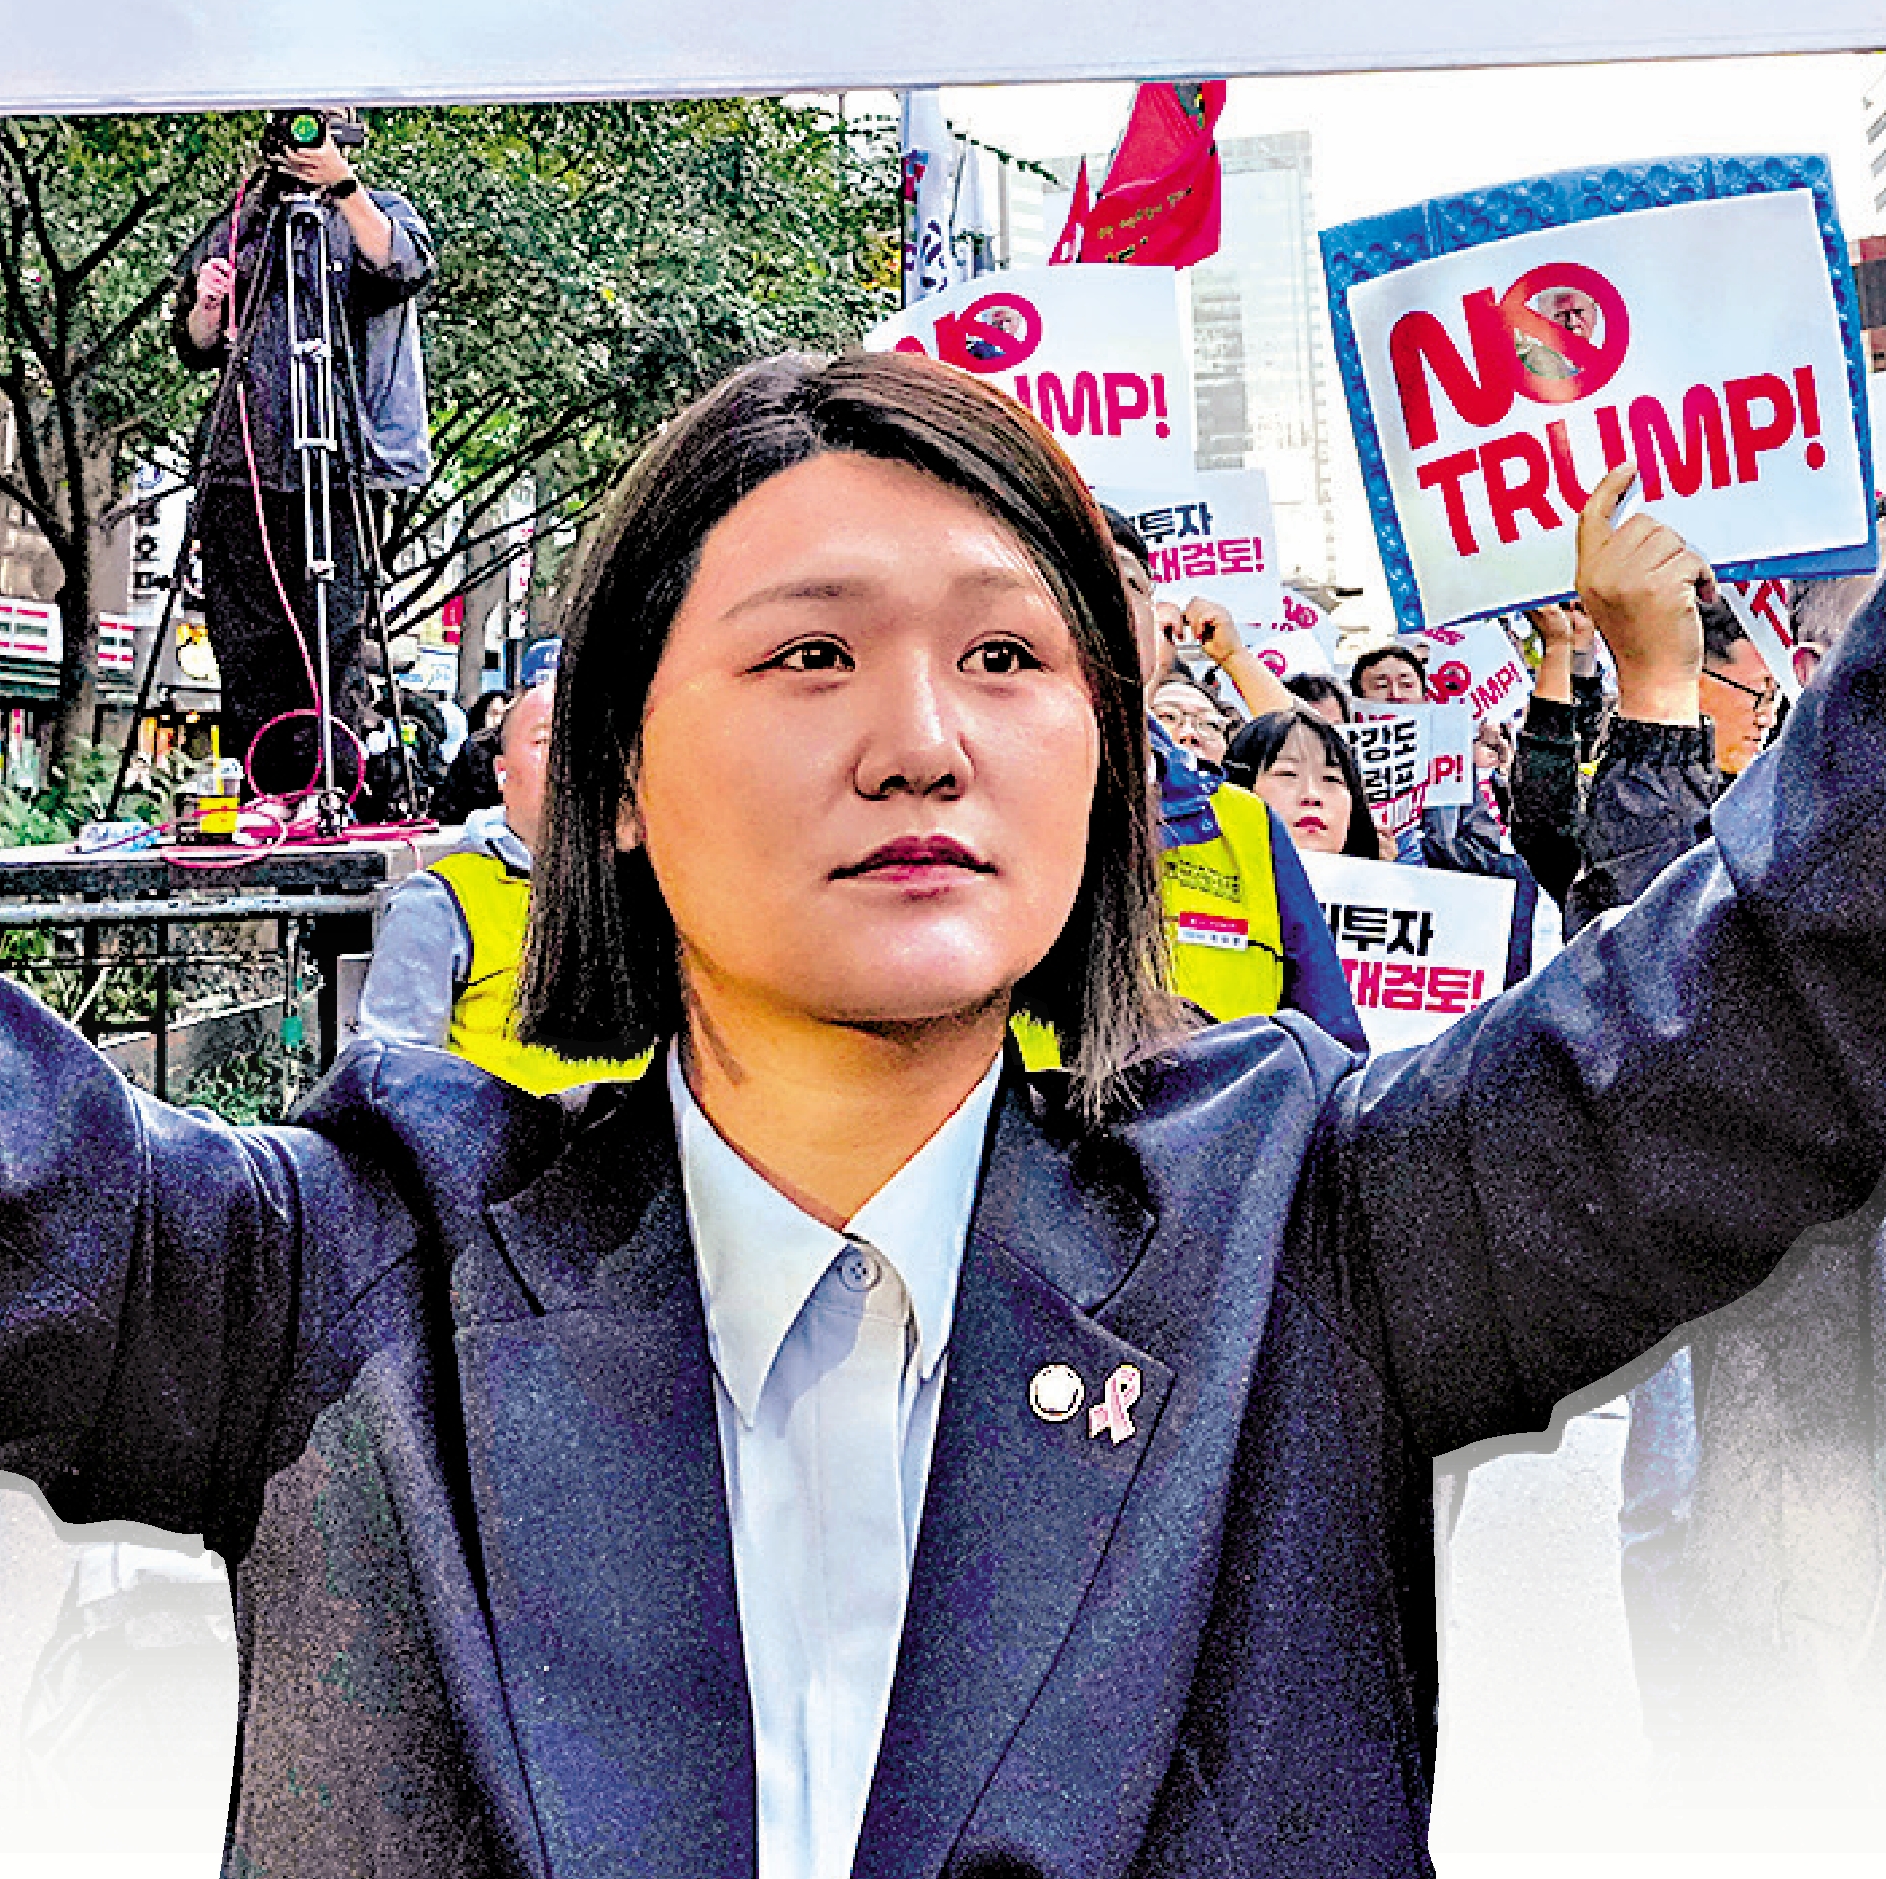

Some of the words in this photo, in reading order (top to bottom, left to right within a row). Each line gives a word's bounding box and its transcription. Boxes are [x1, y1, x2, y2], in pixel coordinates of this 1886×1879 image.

[1389, 262, 1630, 450] NO
[1016, 371, 1171, 439] MP!
[1416, 363, 1826, 557] TRUMP!
[1129, 501, 1213, 544] 투자
[1148, 536, 1265, 584] 재검토!
[1343, 961, 1485, 1015] 재검토!
